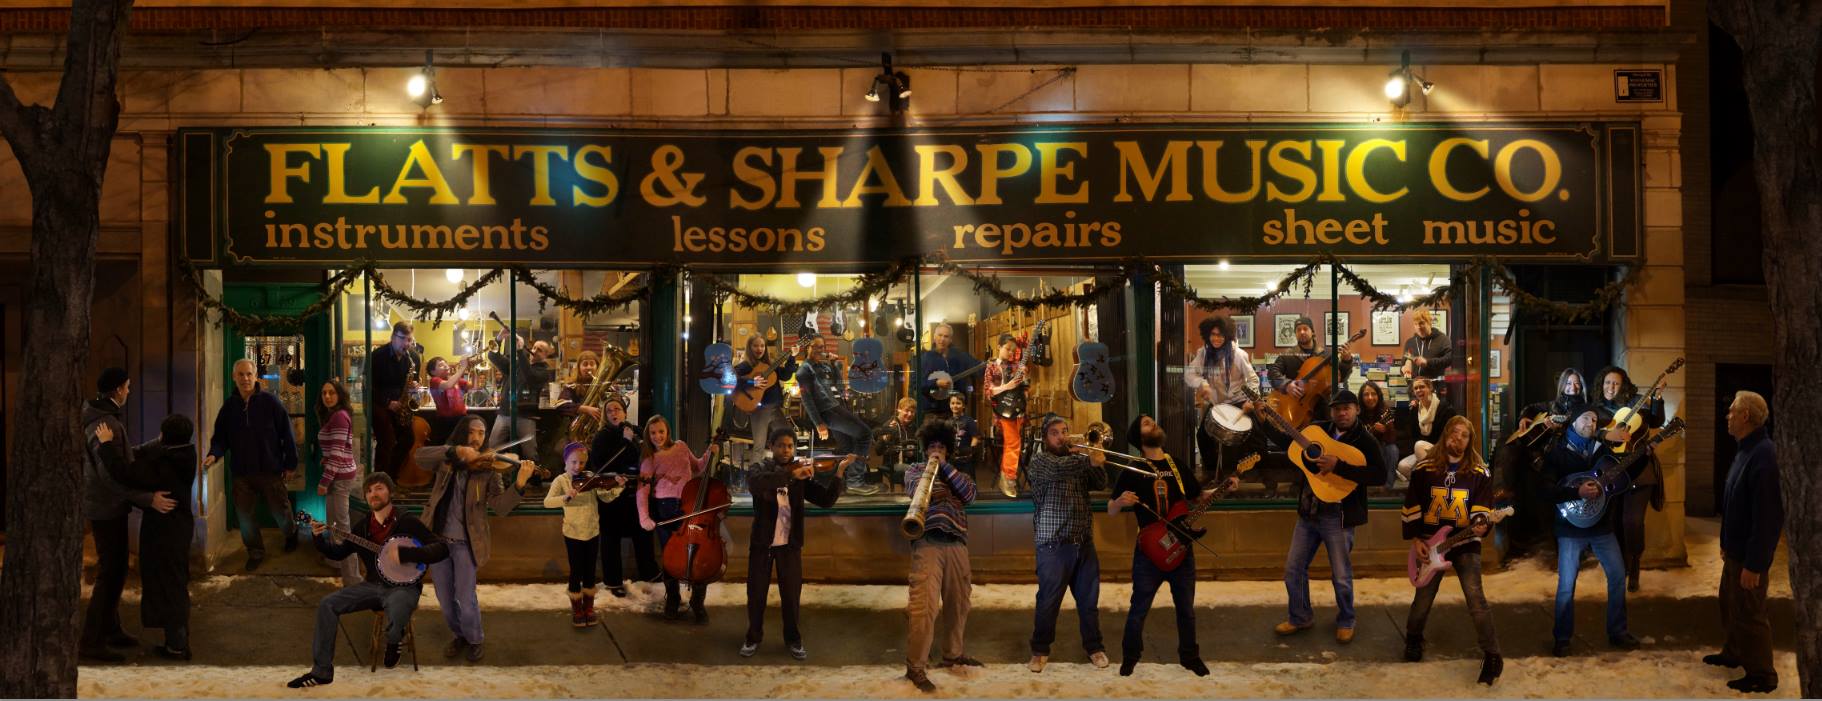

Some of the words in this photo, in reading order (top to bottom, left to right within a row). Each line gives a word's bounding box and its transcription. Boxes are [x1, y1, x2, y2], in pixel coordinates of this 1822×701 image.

[264, 139, 619, 208] FLATTS
[640, 145, 706, 206] &
[731, 141, 1089, 210] SHARPE
[1114, 138, 1407, 203] MUSIC
[1428, 137, 1570, 202] CO.
[264, 211, 549, 250] instruments
[673, 215, 826, 252] lessons
[953, 211, 1122, 255] repairs
[1264, 208, 1389, 245] sheet
[1422, 210, 1556, 244] music
[1424, 487, 1471, 528] M
